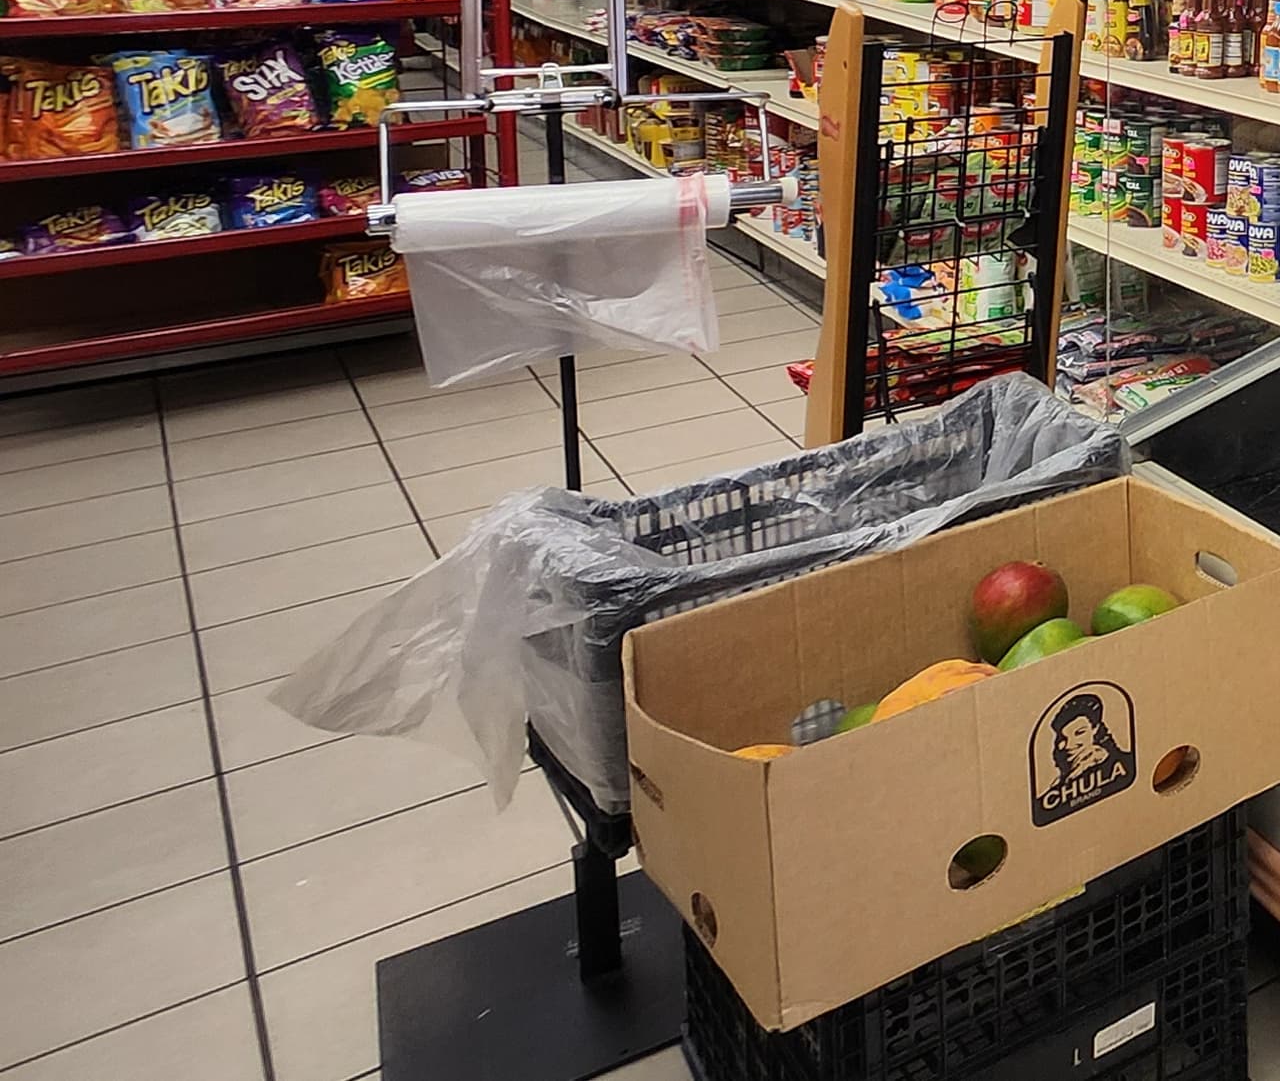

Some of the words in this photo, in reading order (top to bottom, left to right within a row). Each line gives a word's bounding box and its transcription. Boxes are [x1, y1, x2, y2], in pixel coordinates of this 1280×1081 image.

[127, 57, 210, 115] Takis
[218, 58, 259, 81] Taki
[24, 70, 101, 119] Takis
[1228, 159, 1252, 172] OYA
[250, 178, 306, 212] Takis
[39, 205, 104, 235] Takis
[134, 193, 213, 231] Takis
[1249, 225, 1275, 240] OYA
[337, 250, 397, 283] Takis
[1041, 761, 1127, 810] CHULA
[1069, 787, 1103, 808] BRAND
